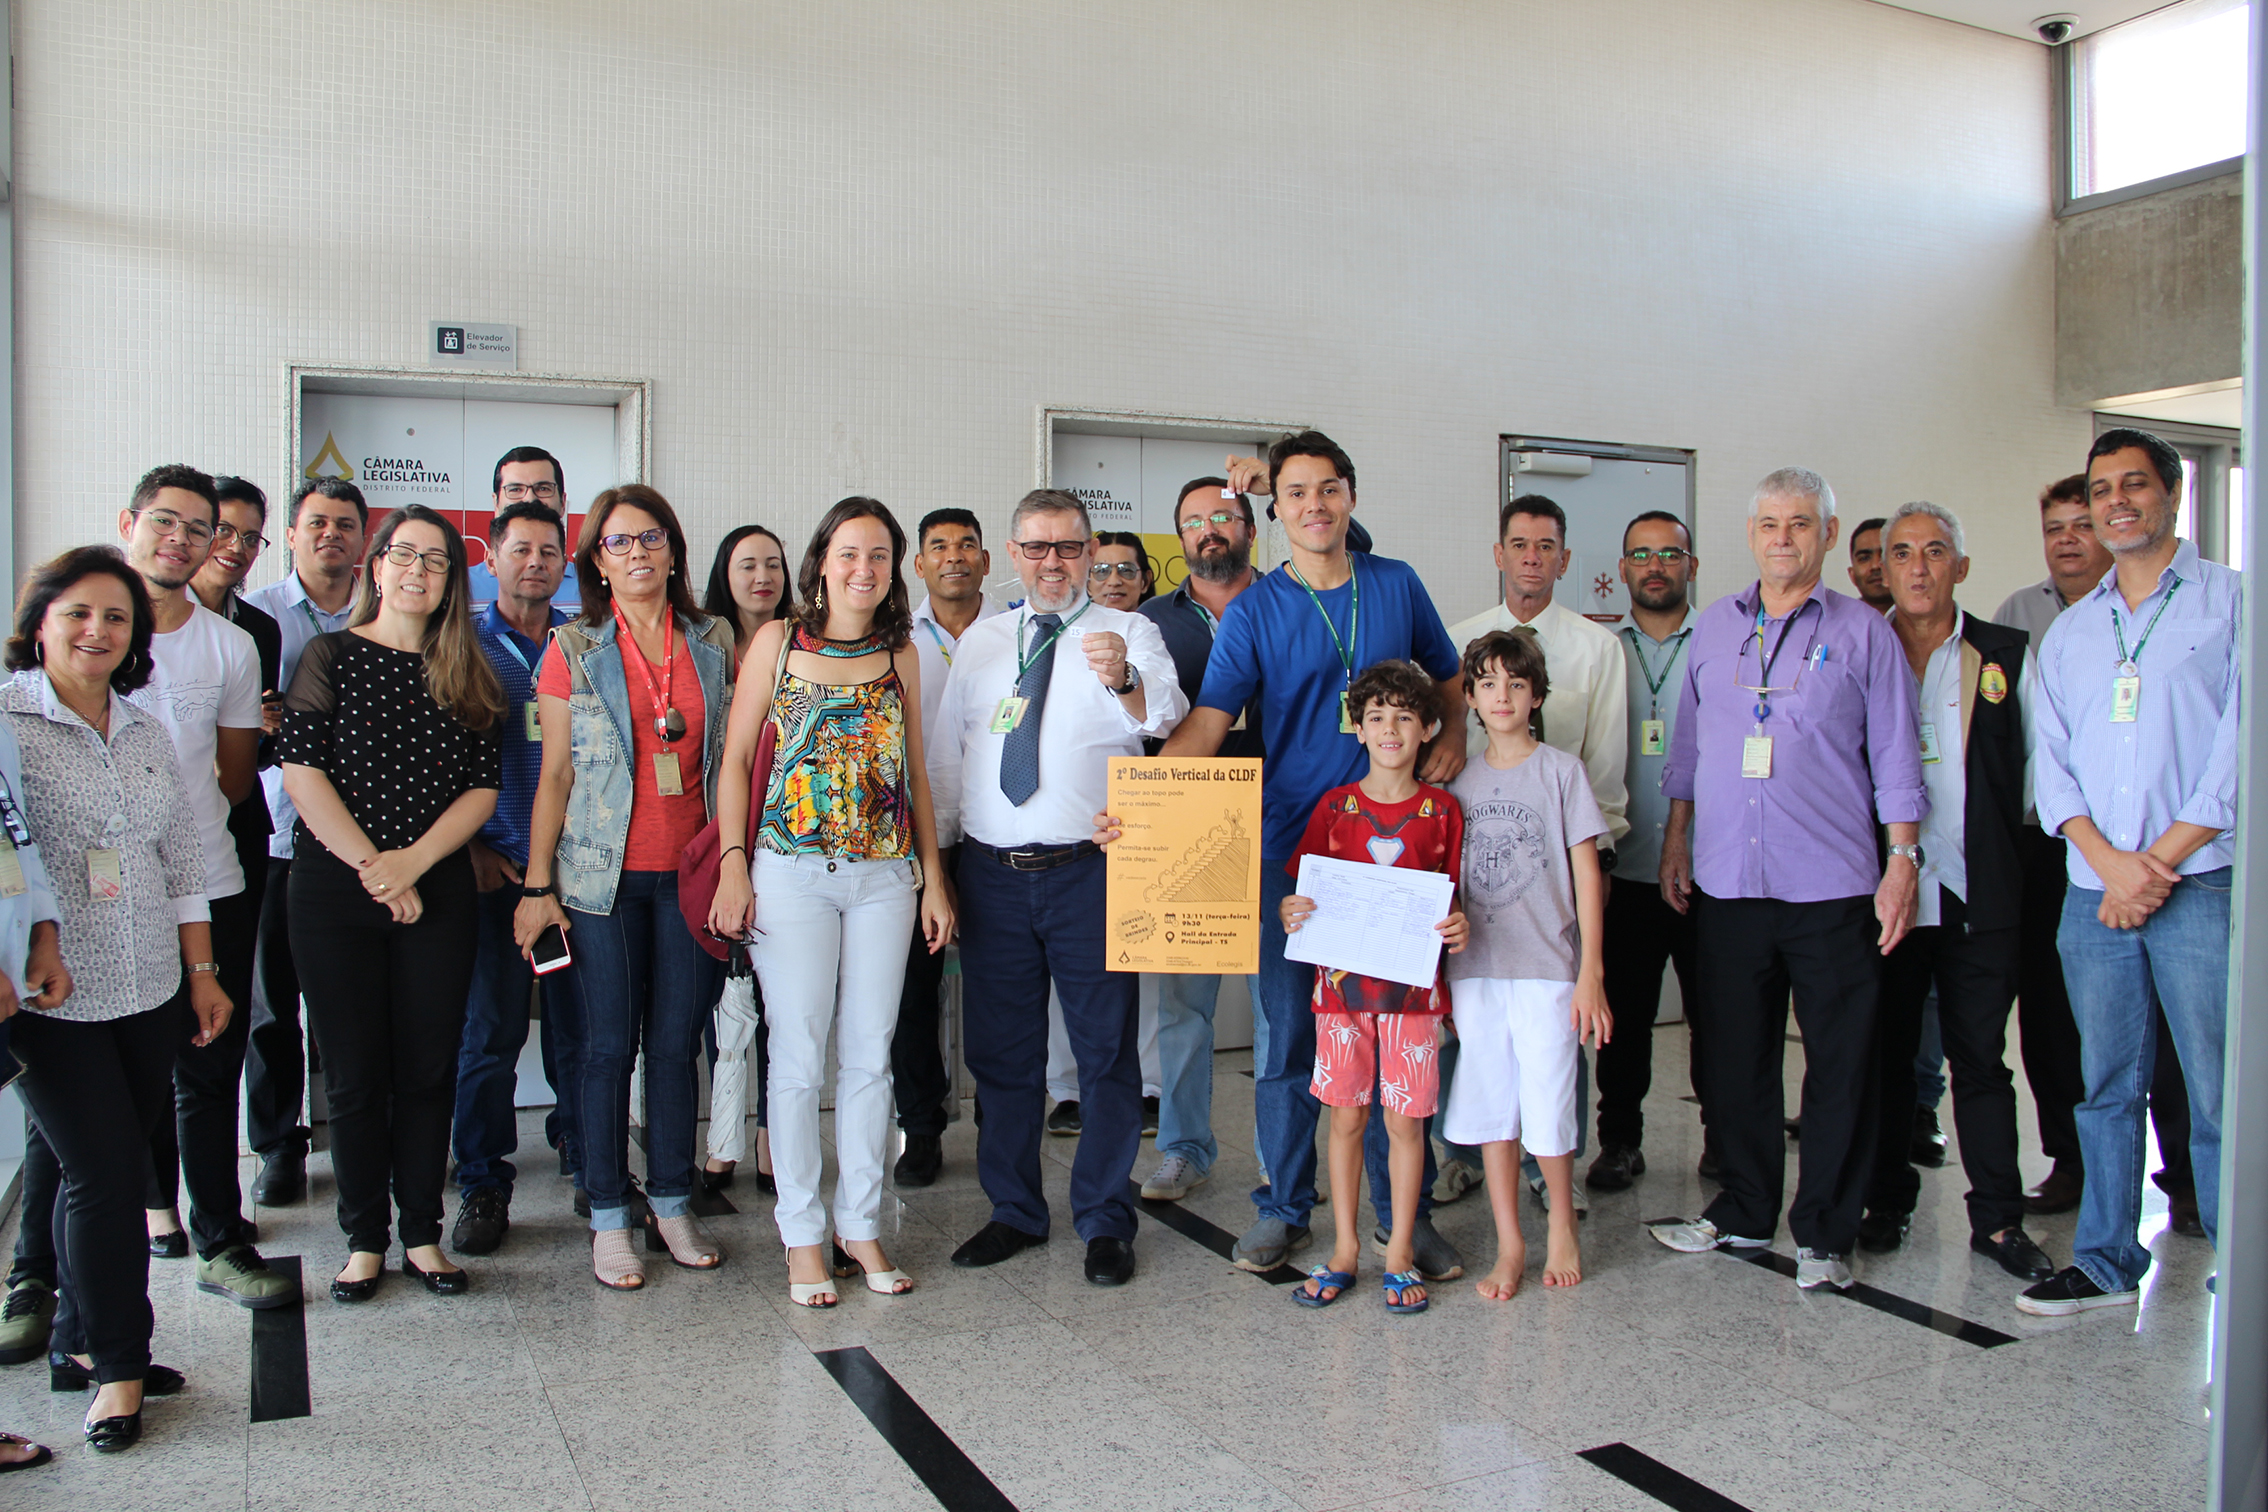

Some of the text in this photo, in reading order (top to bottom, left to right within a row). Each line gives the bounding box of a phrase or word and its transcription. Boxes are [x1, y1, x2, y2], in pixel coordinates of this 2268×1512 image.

[467, 333, 503, 342] Elevador
[479, 343, 510, 353] Serviço
[363, 456, 424, 471] CÂMARA
[363, 470, 451, 484] LEGISLATIVA
[363, 484, 451, 493] DISTRITO FEDERAL
[1071, 628, 1080, 636] 15
[1116, 767, 1257, 781] 2º Desafio Vertical da CLDF
[1117, 789, 1141, 797] Chegar
[1485, 851, 1500, 869] H
